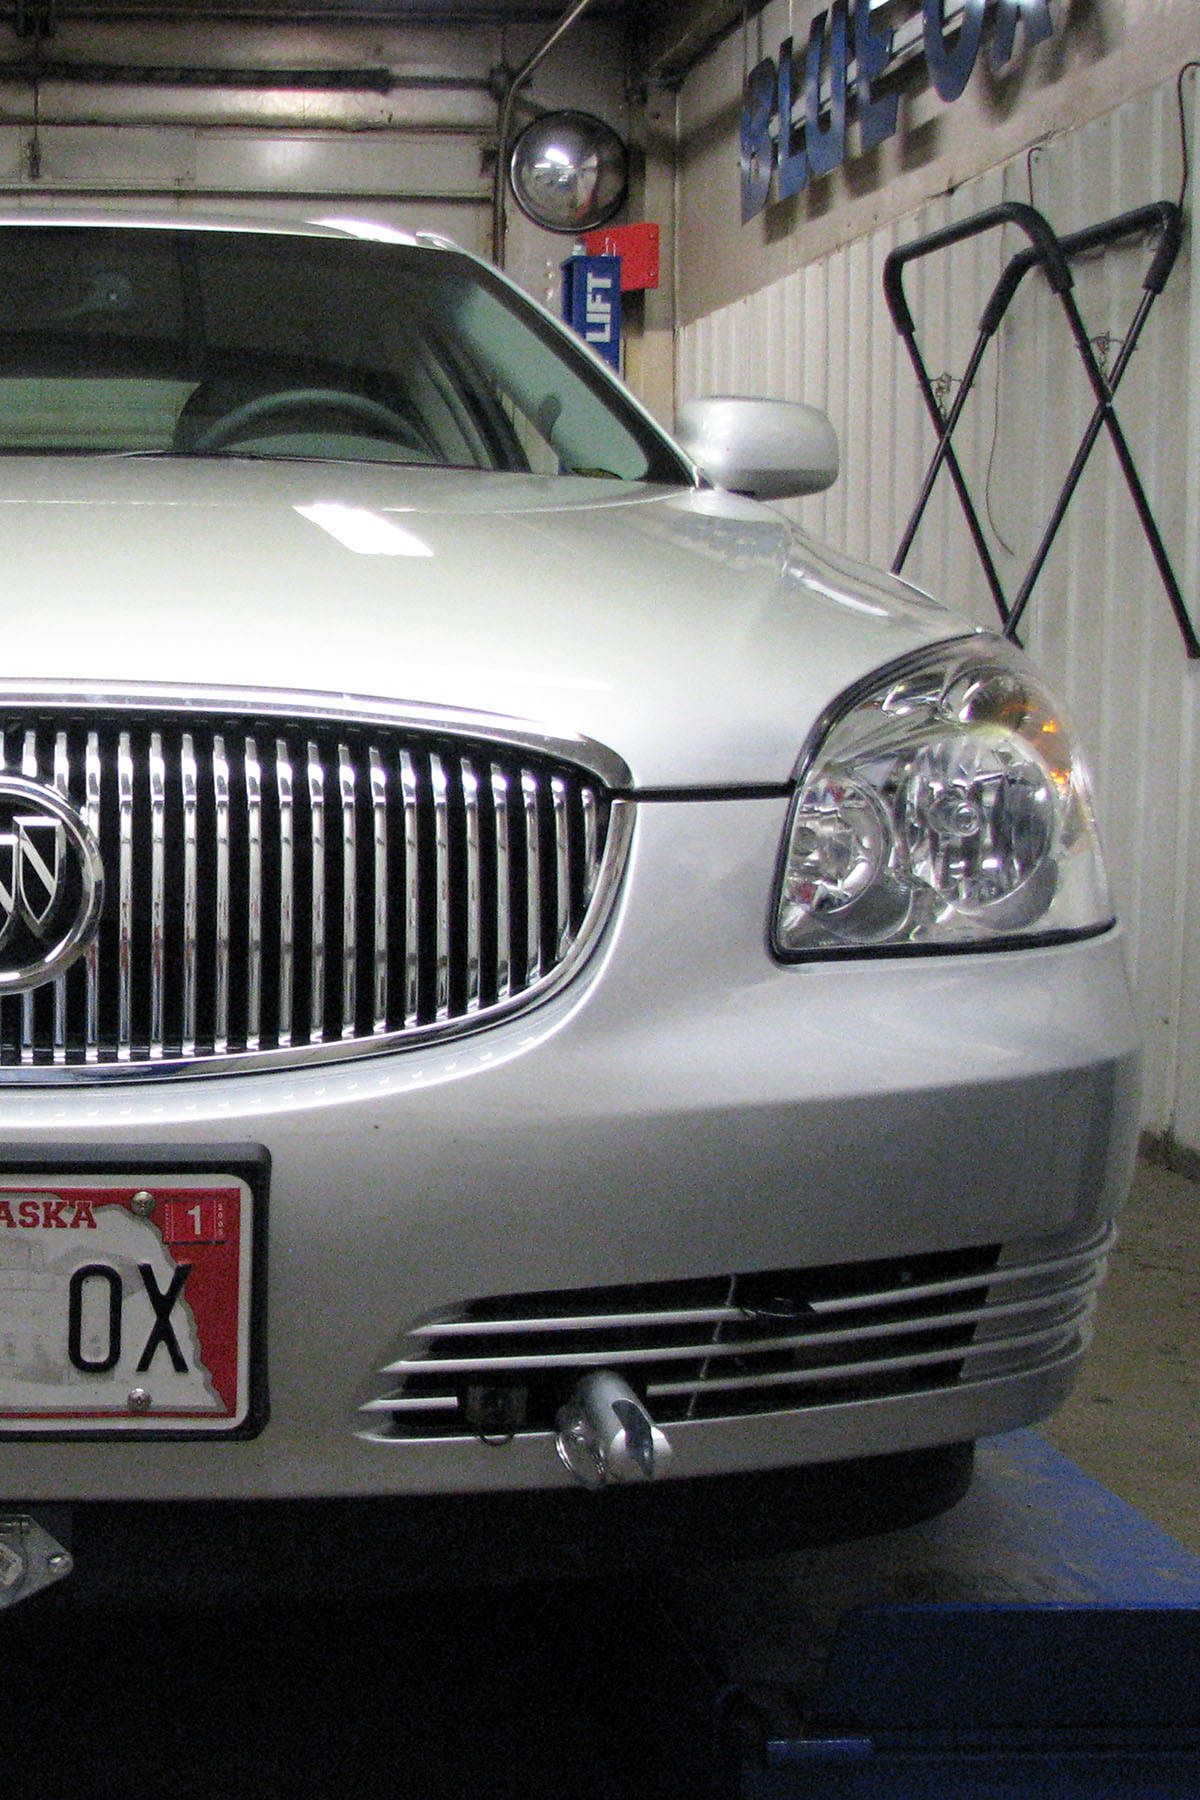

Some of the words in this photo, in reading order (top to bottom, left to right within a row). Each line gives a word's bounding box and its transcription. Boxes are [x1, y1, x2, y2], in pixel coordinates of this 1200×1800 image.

[586, 272, 611, 342] LIFT
[188, 1205, 201, 1235] 1
[68, 1263, 193, 1373] OX
